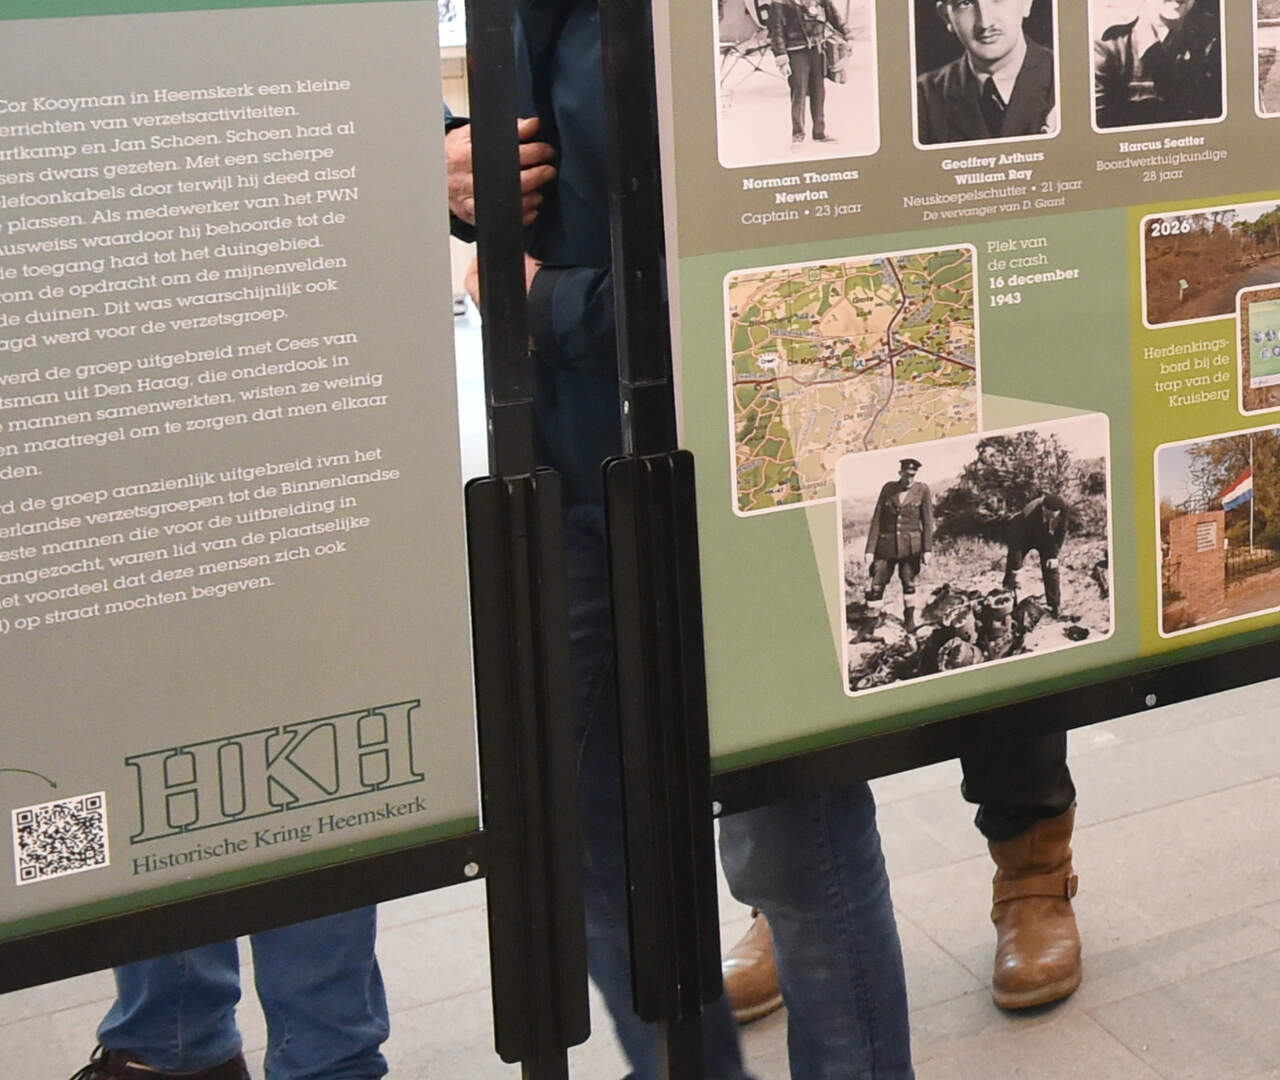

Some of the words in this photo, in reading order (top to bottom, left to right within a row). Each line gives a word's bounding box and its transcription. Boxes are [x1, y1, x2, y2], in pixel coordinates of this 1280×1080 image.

[32, 94, 126, 111] Kooyman
[130, 92, 149, 104] in
[153, 83, 254, 102] Heemskerk
[257, 83, 292, 95] een
[295, 79, 351, 93] kleine
[89, 118, 128, 130] van
[131, 105, 299, 127] verzetsactiviteiten.
[1119, 141, 1162, 152] Harcus
[1164, 136, 1204, 148] Seatter
[942, 157, 996, 170] Geoffrey
[998, 152, 1044, 164] Arthurs
[1096, 149, 1227, 171] Boordwerktuigkundige
[743, 176, 800, 189] Norman
[803, 170, 859, 183] Thomas
[955, 172, 1005, 184] William
[1008, 169, 1032, 180] Ray
[1143, 170, 1157, 182] 28
[1159, 170, 1183, 182] jaar
[775, 190, 828, 203] Newton
[903, 185, 1026, 207] Neuskoepelschutter
[1041, 181, 1053, 192] 21
[1057, 180, 1082, 193] jaar
[741, 209, 799, 225] Captain
[815, 204, 831, 216] 23
[834, 204, 862, 216] jaar
[1151, 219, 1191, 238] 2026
[987, 239, 1017, 253] Plek
[1019, 237, 1048, 248] van
[987, 258, 1006, 271] de
[1009, 253, 1048, 268] crash
[990, 276, 1004, 288] 16
[1008, 268, 1079, 286] december
[990, 292, 1021, 306] 1943
[1143, 338, 1229, 359] Herdenkings-
[1160, 359, 1191, 374] bord
[1193, 357, 1209, 369] bij
[1212, 354, 1229, 365] de
[1154, 380, 1182, 392] trap
[1184, 375, 1211, 387] van
[1212, 371, 1230, 383] de
[1169, 389, 1230, 407] Kruisberg
[125, 699, 425, 845] HKH
[132, 838, 248, 875] Historische
[253, 825, 312, 848] Kring
[317, 796, 427, 834] Heemskerk
